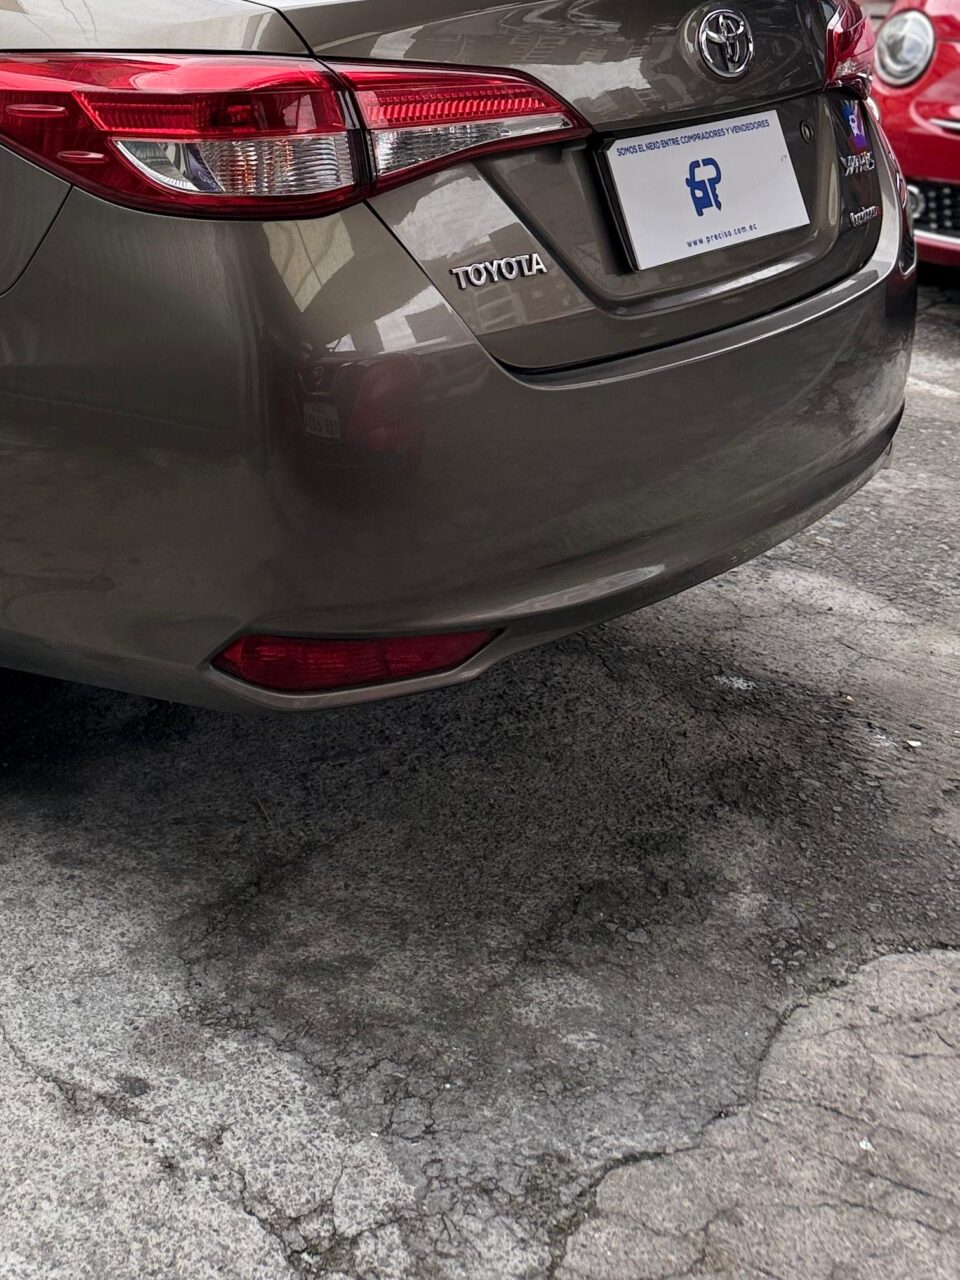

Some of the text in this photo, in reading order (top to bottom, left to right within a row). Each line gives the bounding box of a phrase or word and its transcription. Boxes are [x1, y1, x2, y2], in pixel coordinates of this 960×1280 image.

[616, 145, 638, 157] SOMOS
[645, 140, 661, 152] NEXO
[661, 136, 681, 148] ENTRE
[681, 128, 726, 144] COMPRADORES
[730, 119, 770, 134] VENDEDORES
[686, 223, 758, 247] www.preciso.com.ec
[449, 253, 548, 289] TOYOTA
